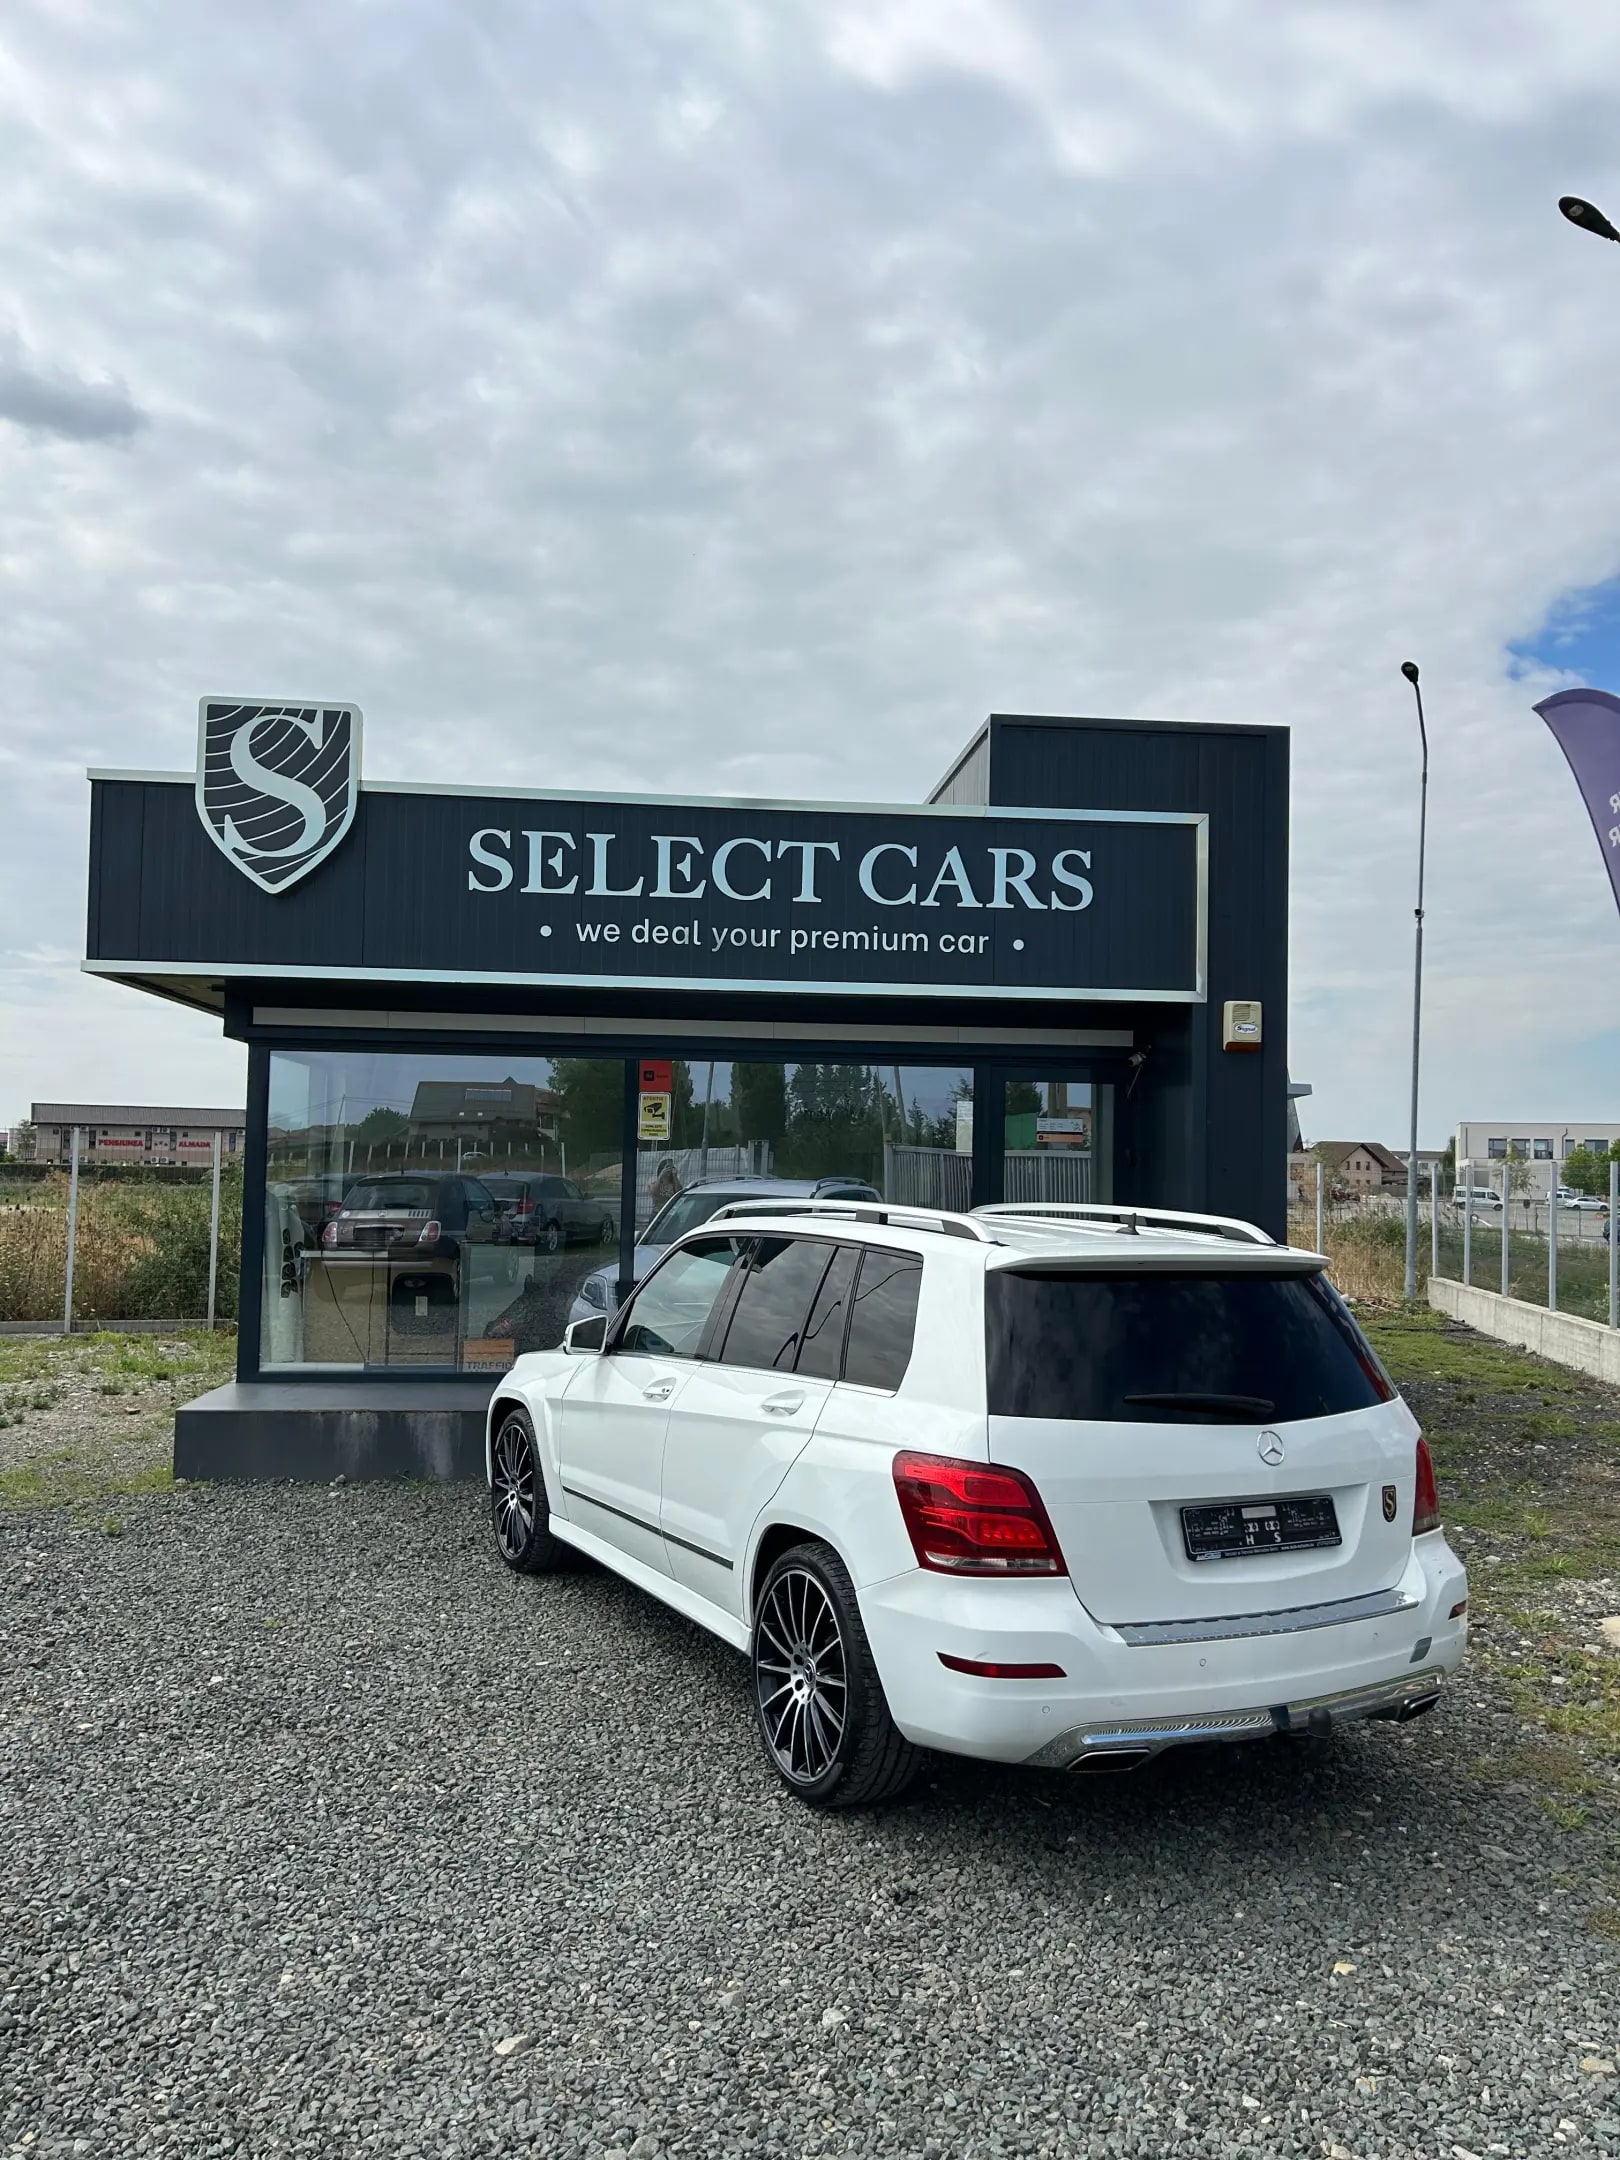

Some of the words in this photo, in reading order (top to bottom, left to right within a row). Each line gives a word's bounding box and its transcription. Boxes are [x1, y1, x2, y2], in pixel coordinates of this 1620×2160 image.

[224, 707, 327, 858] S
[468, 828, 841, 903] SELECT
[858, 843, 1094, 911] CARS
[575, 923, 621, 943] we
[631, 918, 702, 946] deal
[711, 927, 781, 952] your
[790, 929, 929, 955] premium
[939, 934, 990, 954] car
